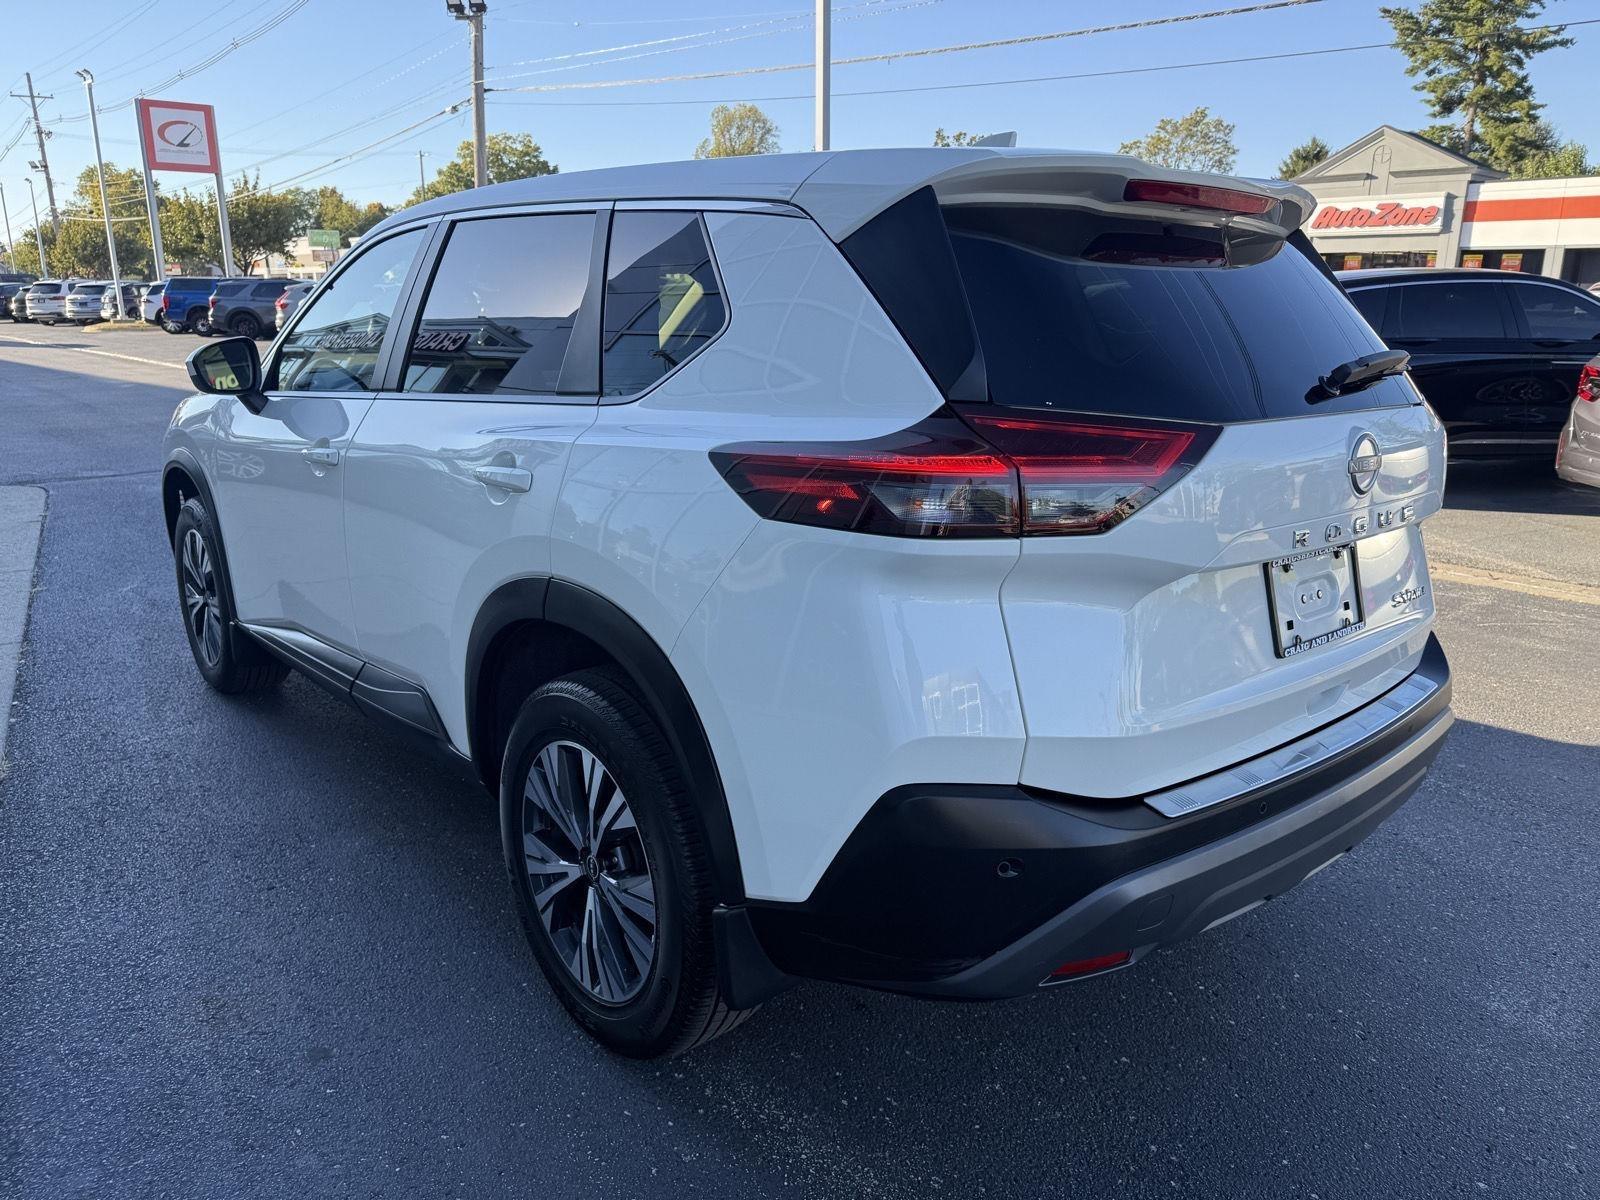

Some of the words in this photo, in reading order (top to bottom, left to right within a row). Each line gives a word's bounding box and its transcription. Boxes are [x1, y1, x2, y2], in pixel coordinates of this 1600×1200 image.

[1311, 202, 1440, 229] AutoZone
[1292, 505, 1416, 549] ROGUE
[1284, 642, 1310, 658] CRAIG
[1311, 635, 1330, 648] AND
[1328, 622, 1365, 643] LANDRETH
